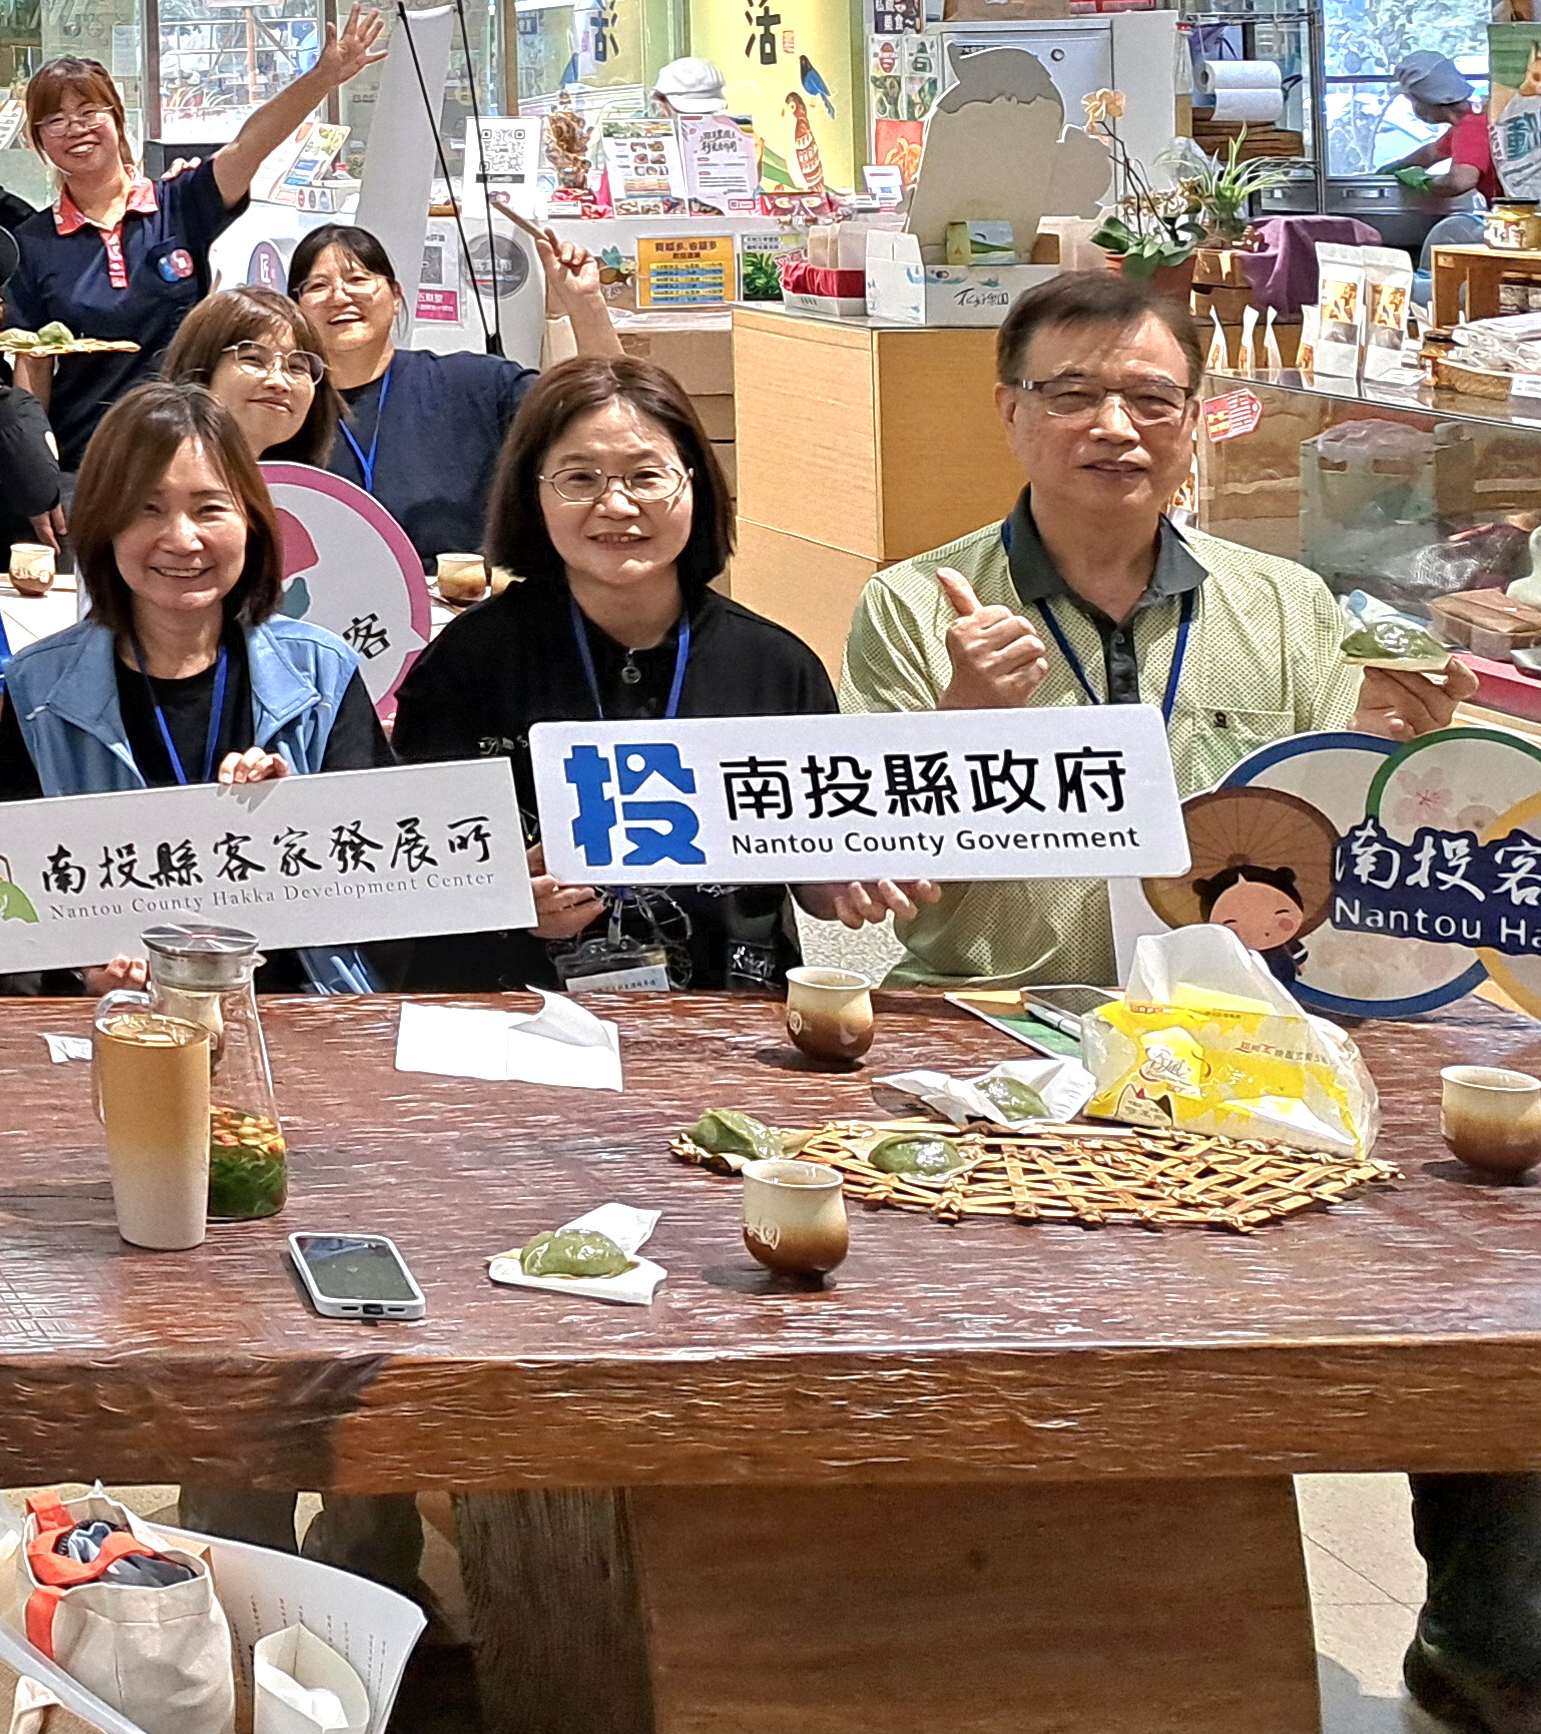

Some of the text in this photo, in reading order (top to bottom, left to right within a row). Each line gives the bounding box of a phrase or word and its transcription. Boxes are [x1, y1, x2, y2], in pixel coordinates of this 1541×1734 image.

[342, 613, 391, 660] 客
[563, 743, 707, 867] 投
[720, 746, 1126, 822] 南投縣政府
[41, 815, 491, 895] 南投縣客家發展所
[733, 827, 1140, 858] Nantou County Government
[49, 871, 496, 921] Nantou County Hakka Development Center
[1334, 896, 1482, 941] Nantou
